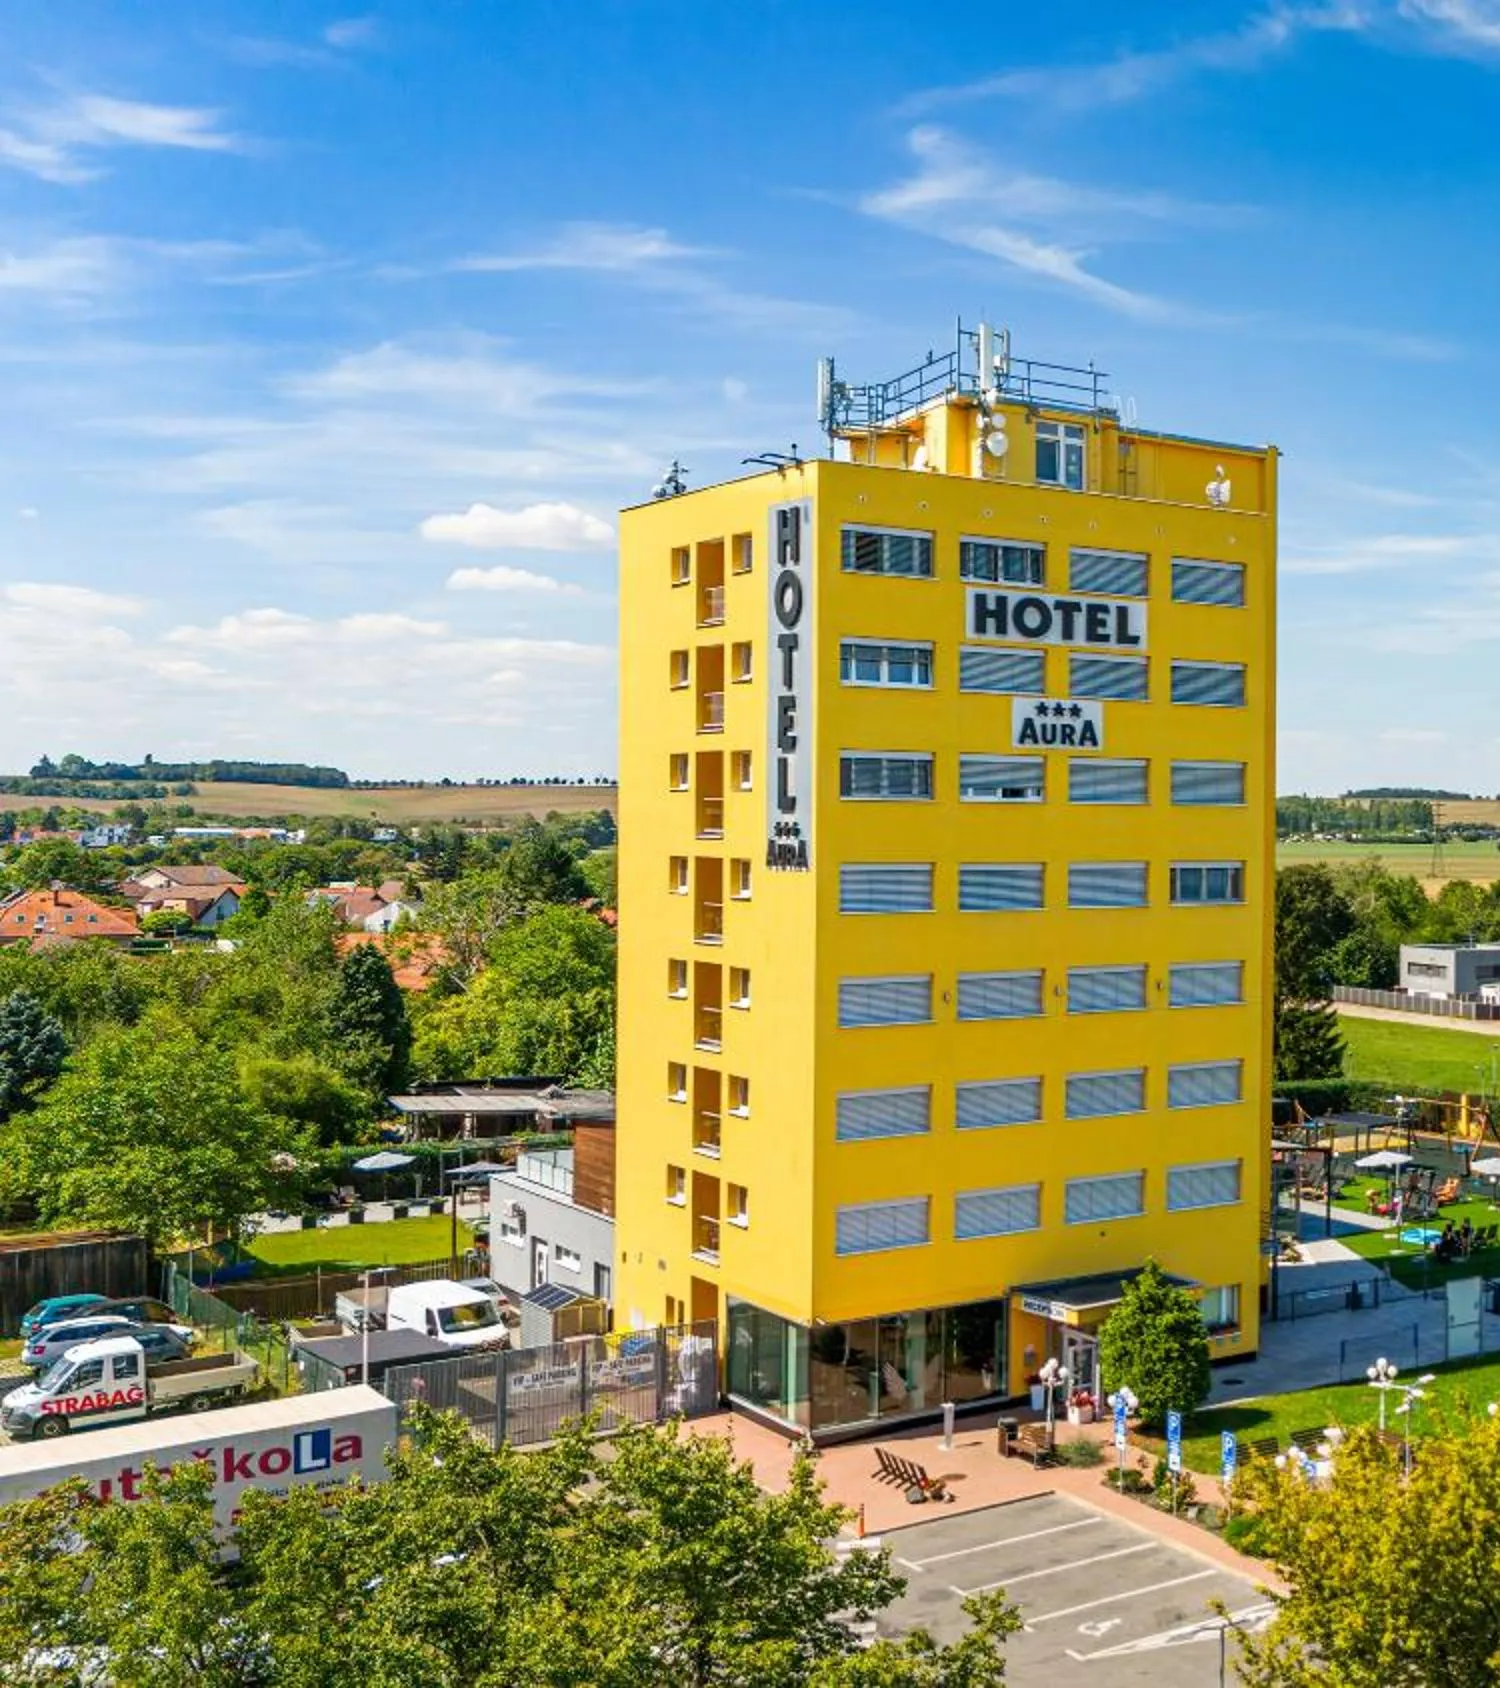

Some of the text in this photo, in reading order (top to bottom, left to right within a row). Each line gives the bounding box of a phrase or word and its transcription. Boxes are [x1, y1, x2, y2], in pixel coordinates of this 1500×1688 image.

[974, 593, 1141, 645] HOTEL
[775, 506, 803, 814] HOTEL
[1018, 717, 1099, 746] AURA
[766, 839, 809, 872] AURA
[41, 1387, 144, 1415] STRABAG
